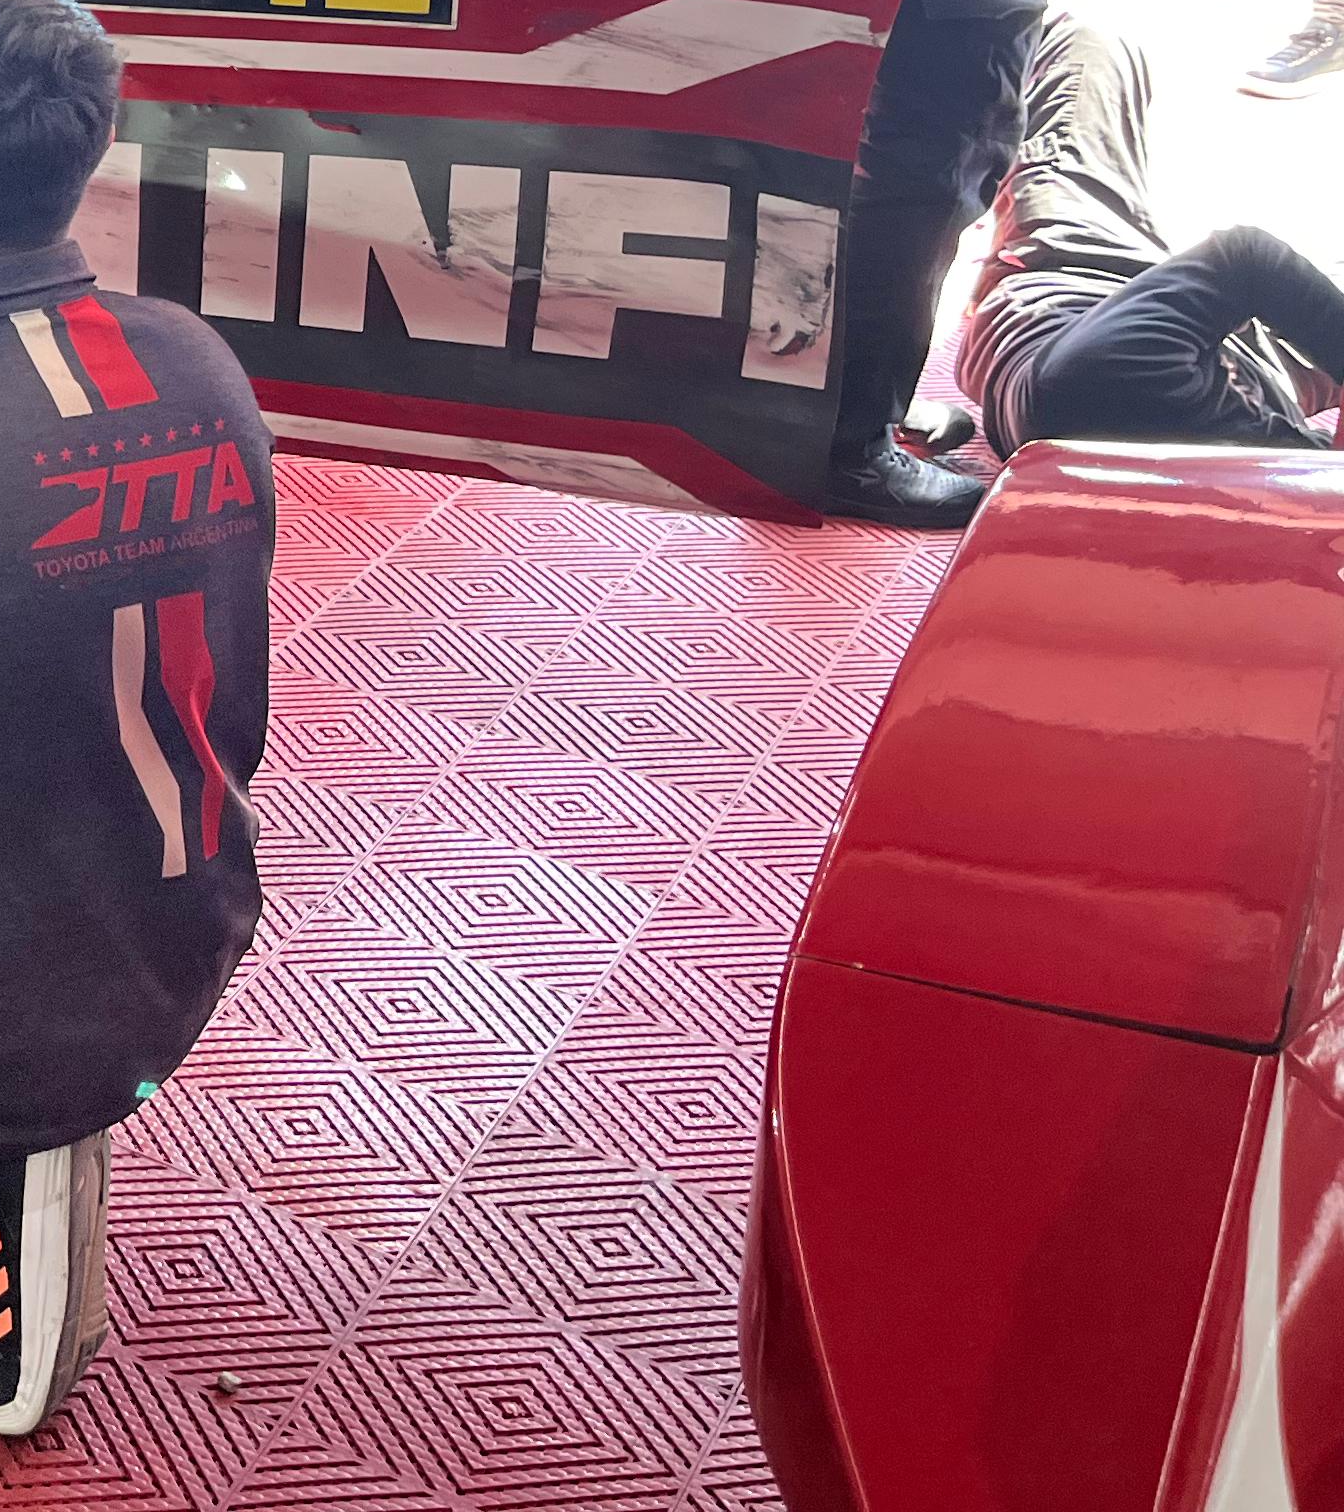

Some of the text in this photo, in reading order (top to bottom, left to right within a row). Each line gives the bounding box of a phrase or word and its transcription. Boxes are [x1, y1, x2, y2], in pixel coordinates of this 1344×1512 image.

[33, 516, 259, 579] TOYOTA TEAM ARGENTINA
